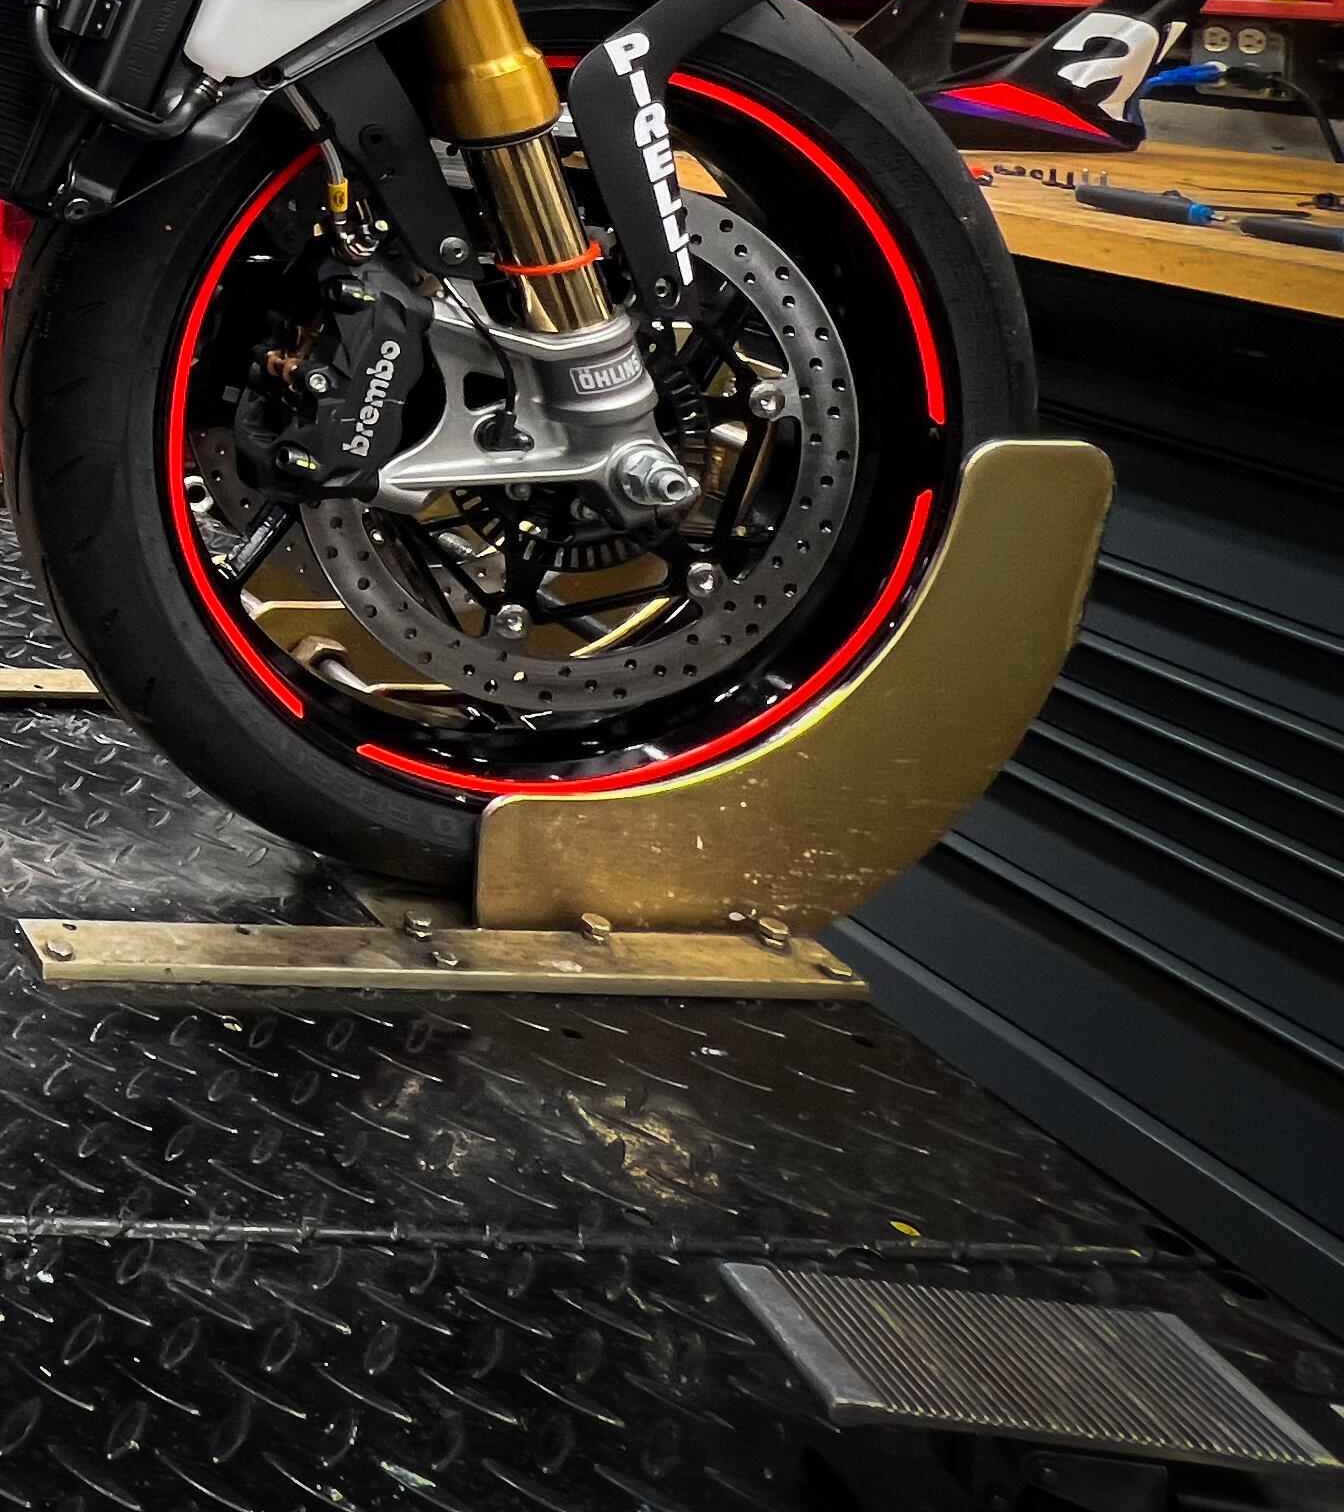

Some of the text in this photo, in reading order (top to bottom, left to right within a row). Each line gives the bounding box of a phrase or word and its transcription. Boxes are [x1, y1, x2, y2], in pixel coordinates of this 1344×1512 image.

[603, 31, 695, 286] PIRELLI
[342, 340, 401, 457] brembo
[578, 353, 641, 390] ÖHLINS
